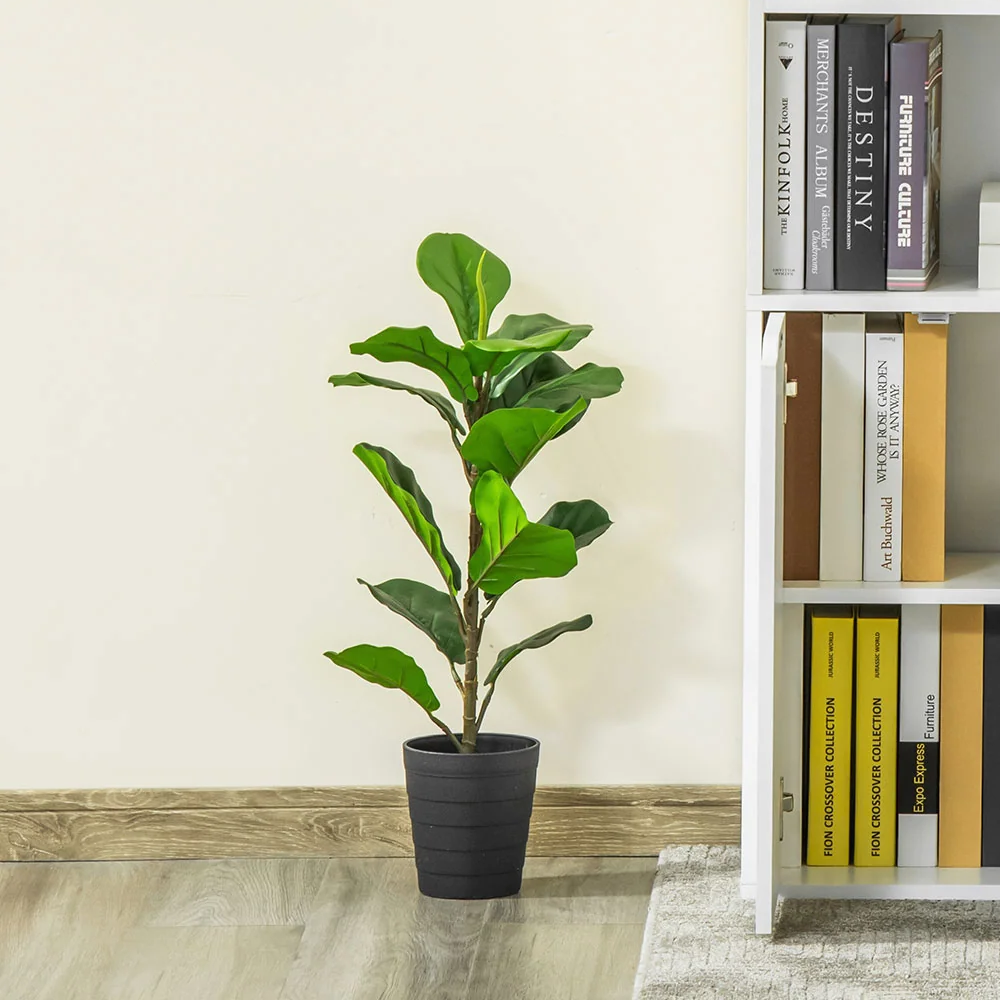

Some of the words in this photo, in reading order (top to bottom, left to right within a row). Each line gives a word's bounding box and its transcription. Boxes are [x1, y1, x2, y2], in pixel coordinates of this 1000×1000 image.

[815, 38, 829, 134] MERCHANTS
[781, 97, 789, 123] HOME
[777, 123, 791, 217] KINFOLK
[814, 144, 828, 199] ALBUM
[854, 85, 874, 232] DESTINY
[780, 217, 788, 236] THE
[897, 182, 912, 248] CULTURE
[877, 360, 887, 407] GARDEN
[877, 410, 887, 438] ROSE
[889, 383, 900, 433] ANYWAY?
[877, 441, 887, 484] WHOSE
[889, 435, 900, 447] IT
[889, 450, 900, 460] IS
[881, 496, 893, 550] Buchwald
[881, 553, 892, 571] Art
[825, 697, 836, 762] COLLECTION
[872, 697, 882, 762] COLLECTION
[923, 694, 936, 740] Furniture
[914, 743, 927, 785] Express
[824, 764, 835, 828] CROSSOVER
[871, 764, 882, 828] CROSSOVER
[913, 786, 927, 813] Expo
[823, 831, 833, 857] FION
[871, 831, 880, 857] FION
